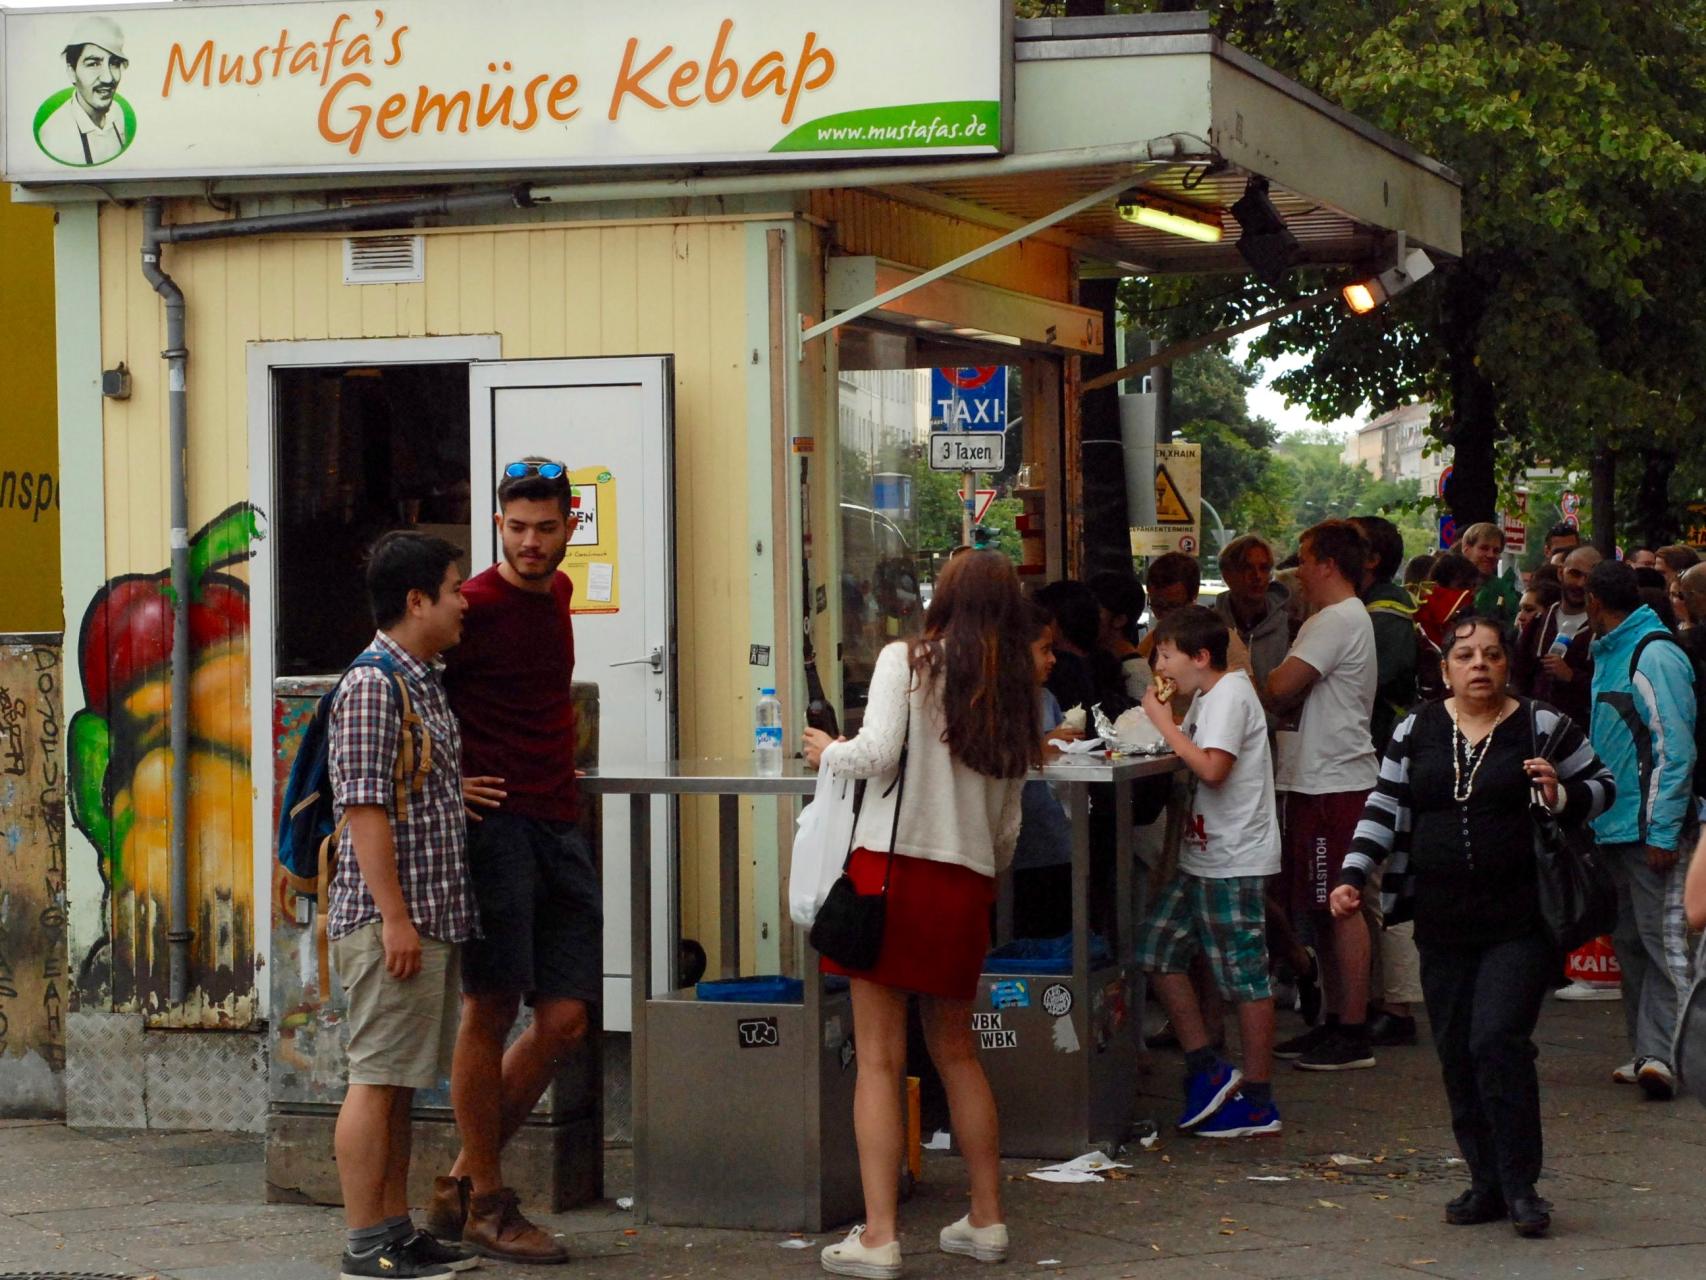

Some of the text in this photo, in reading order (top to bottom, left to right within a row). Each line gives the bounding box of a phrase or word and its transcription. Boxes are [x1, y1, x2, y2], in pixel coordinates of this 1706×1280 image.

[162, 10, 410, 98] Mustafa's
[318, 18, 837, 155] Gemüse Kebap
[817, 114, 987, 144] www.mustafas.de
[937, 398, 1000, 424] TAXI
[943, 441, 991, 460] 3 Taxen
[1167, 449, 1196, 458] XHAIN
[0, 471, 59, 522] nsp
[1315, 837, 1327, 903] HOLLISTER
[981, 1032, 1016, 1048] WBK
